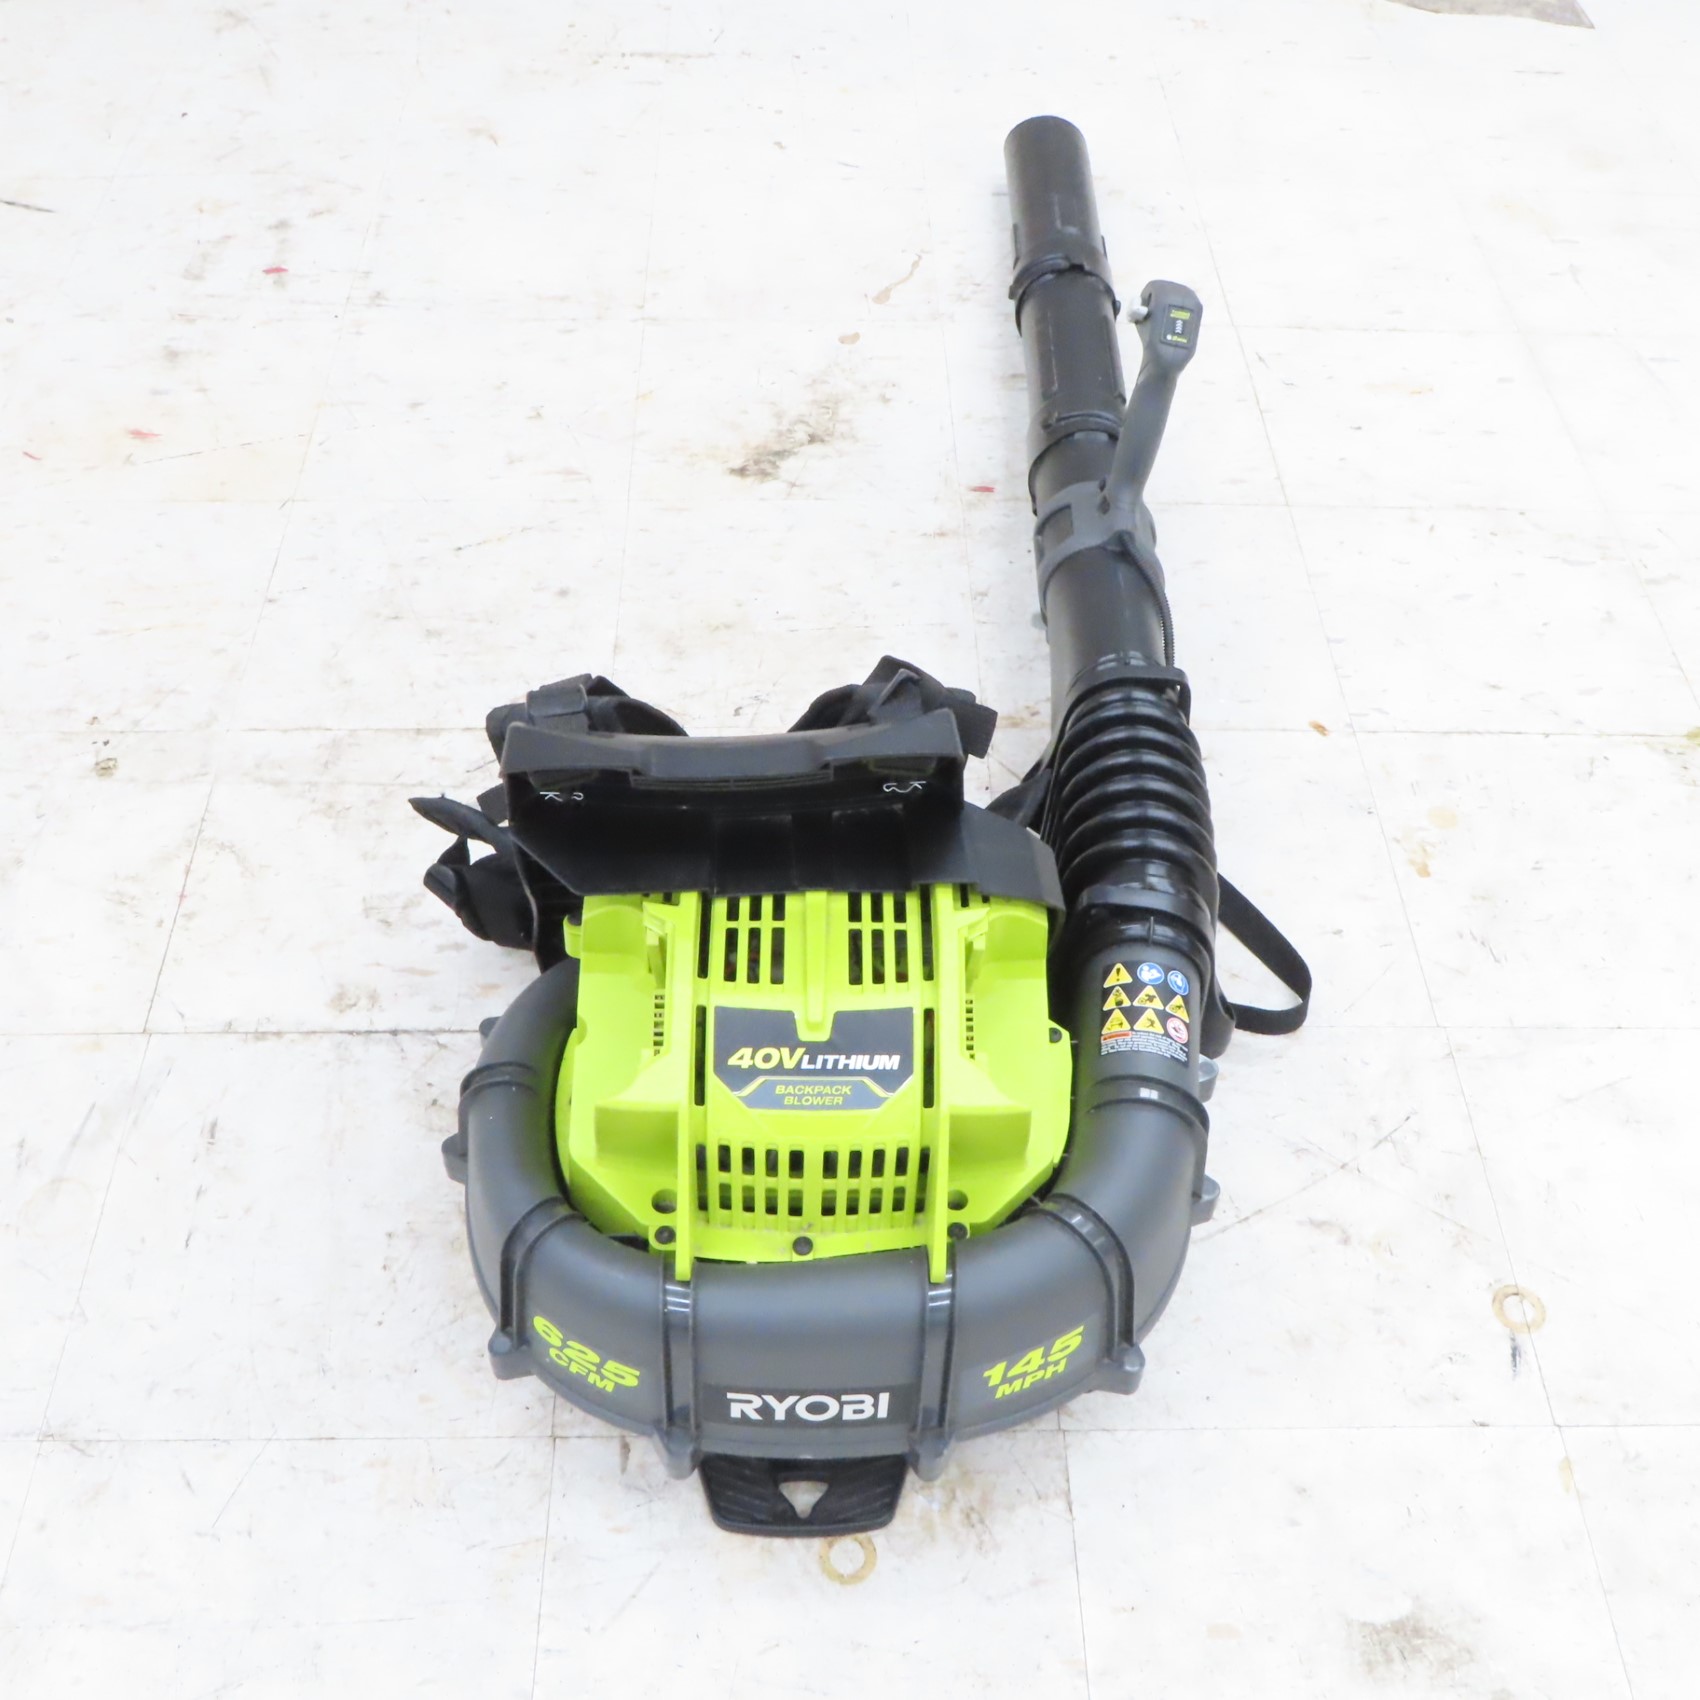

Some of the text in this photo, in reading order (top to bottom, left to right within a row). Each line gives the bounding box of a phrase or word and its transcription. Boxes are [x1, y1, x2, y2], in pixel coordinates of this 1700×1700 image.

[800, 1054, 901, 1071] LITHIUM
[775, 1084, 852, 1096] BACKPACK
[783, 1095, 844, 1106] BLOWER
[533, 1315, 640, 1387] 625
[983, 1324, 1084, 1387] 145
[548, 1347, 616, 1393] CFM
[994, 1357, 1068, 1399] MPH
[726, 1391, 890, 1422] RYOBI
